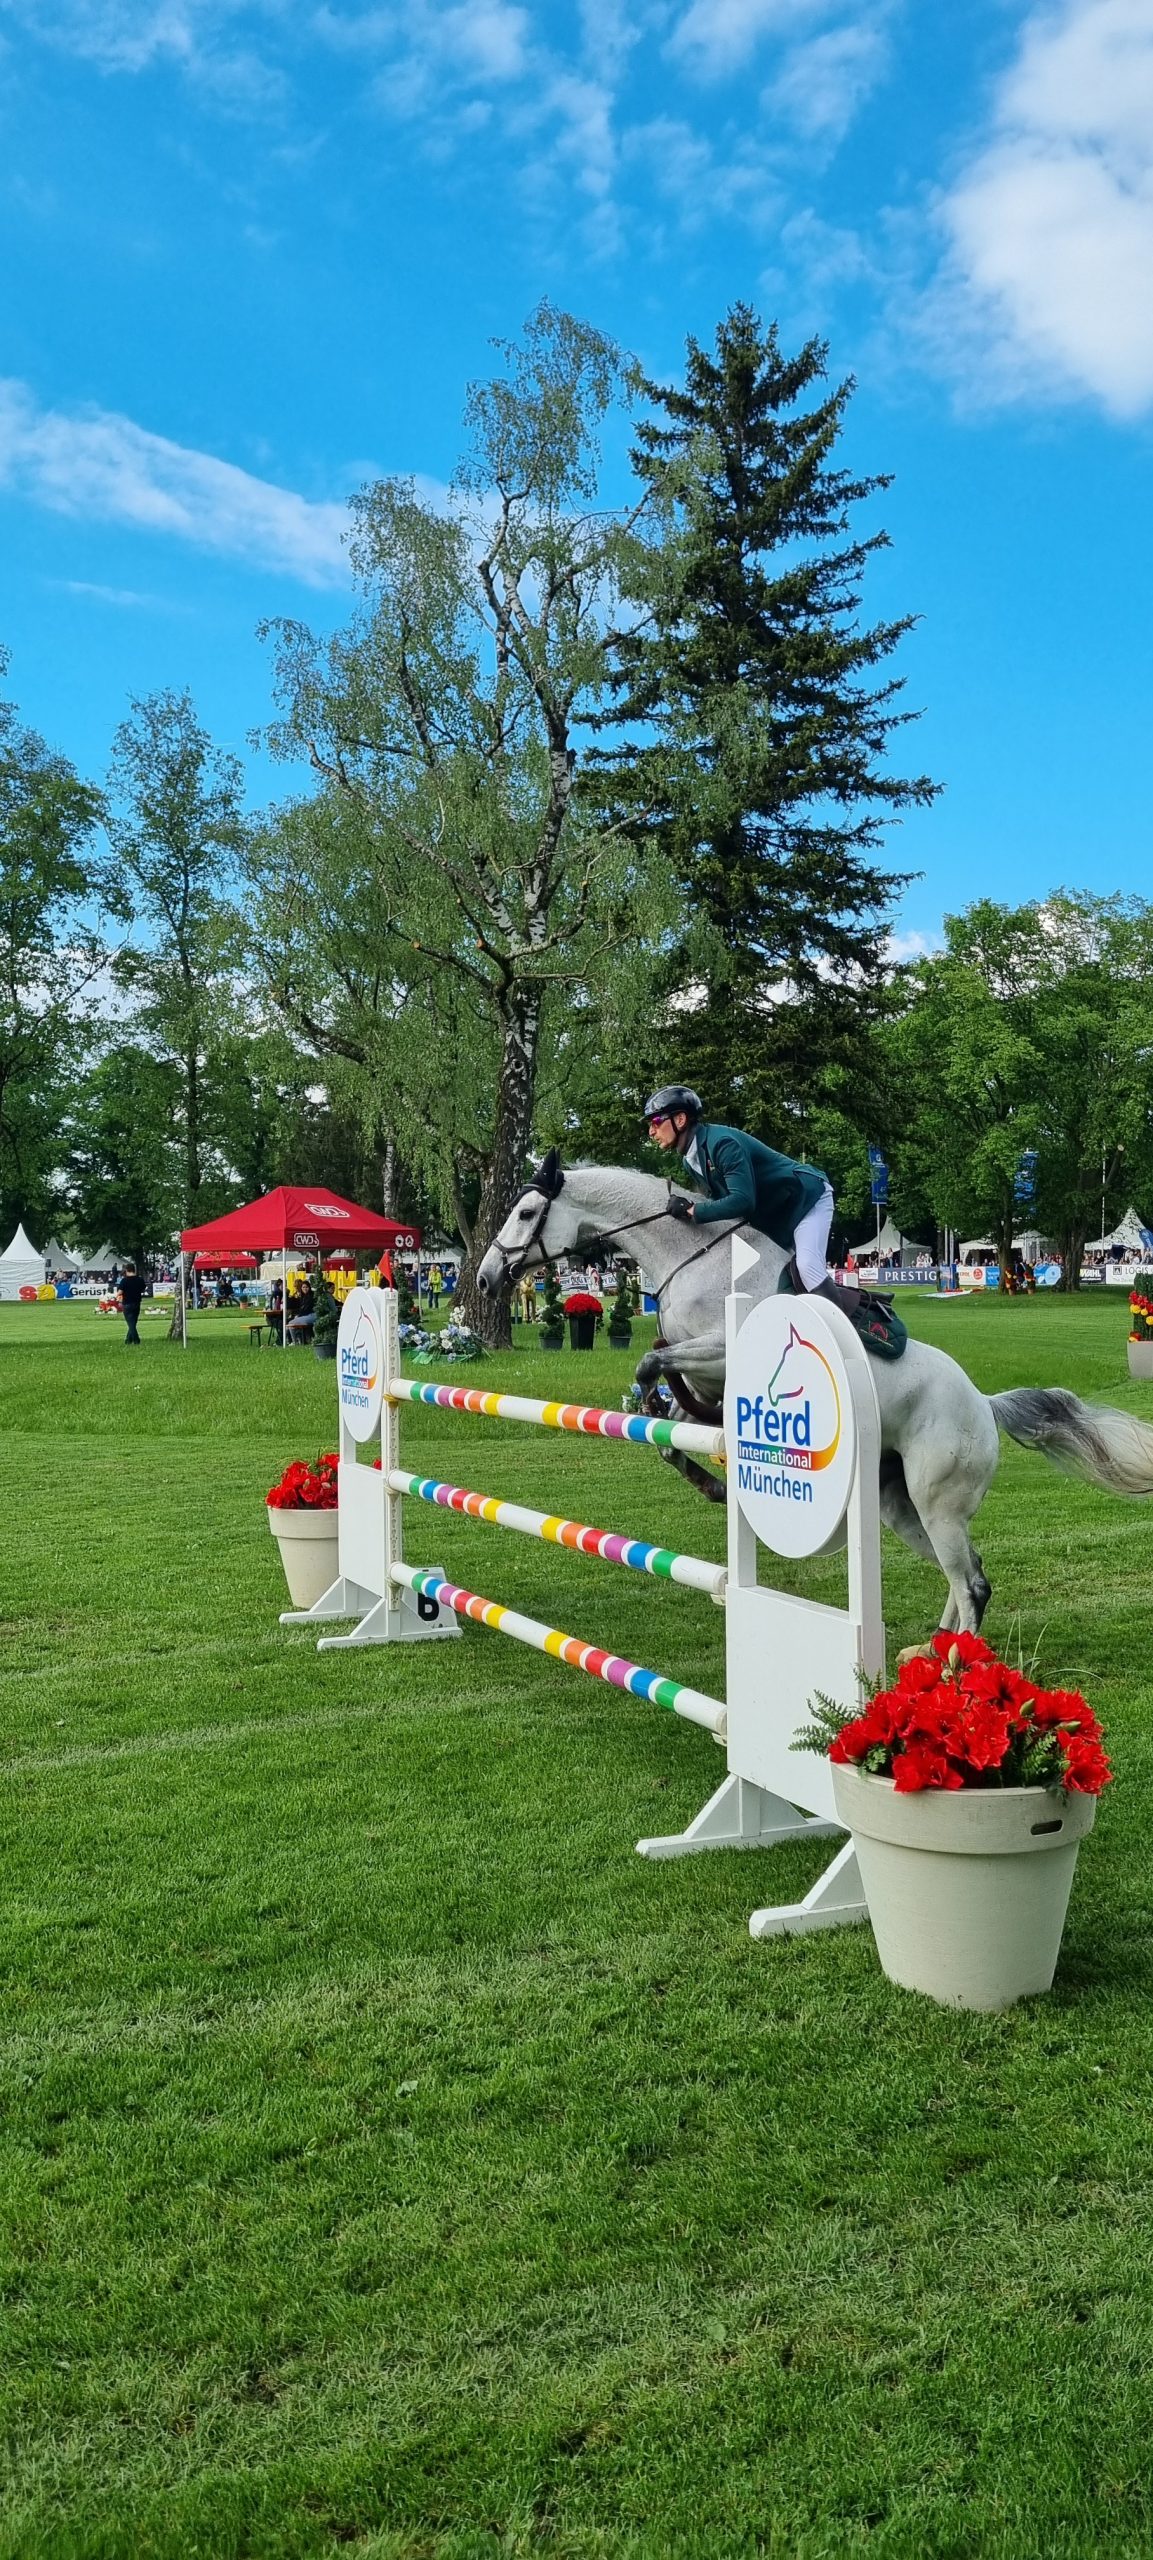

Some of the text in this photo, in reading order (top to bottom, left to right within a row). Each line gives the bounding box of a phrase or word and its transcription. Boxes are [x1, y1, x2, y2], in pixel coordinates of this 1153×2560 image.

[884, 1271, 937, 1281] PRESTIG
[341, 1347, 369, 1376] Pferd
[342, 1389, 369, 1408] München
[737, 1396, 811, 1447] Pferd
[738, 1443, 812, 1469] International
[738, 1464, 813, 1503] München
